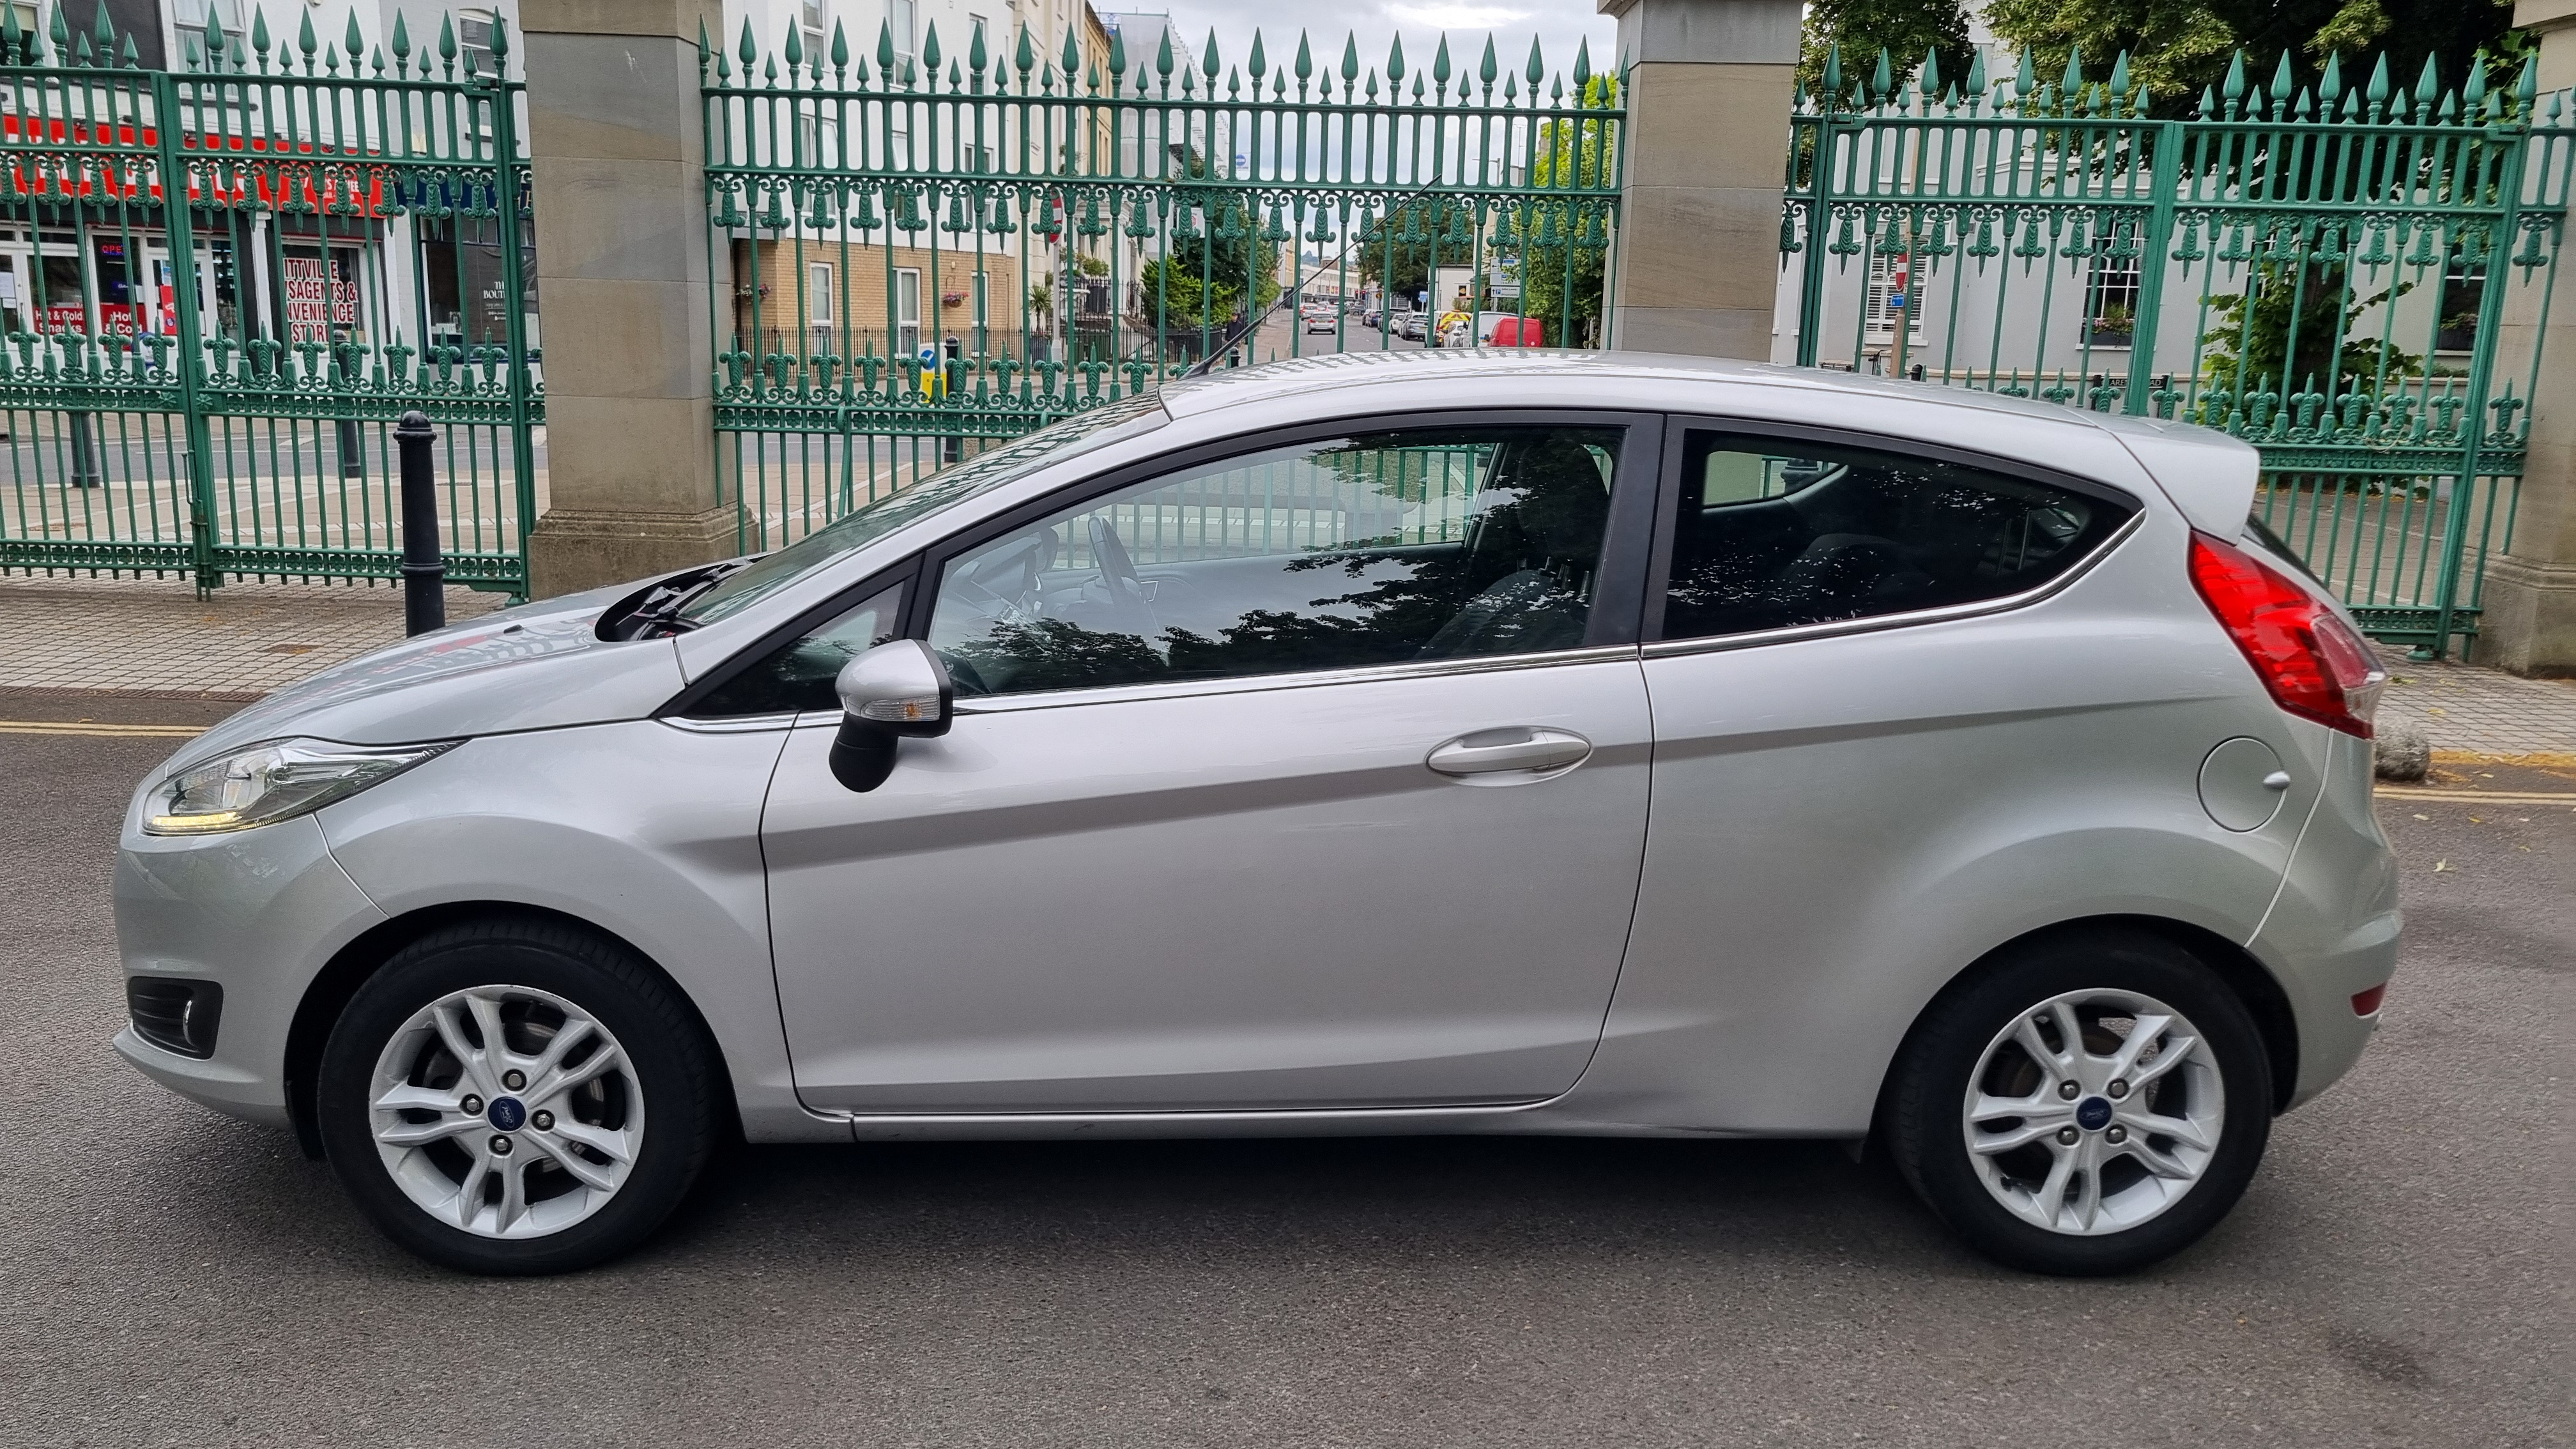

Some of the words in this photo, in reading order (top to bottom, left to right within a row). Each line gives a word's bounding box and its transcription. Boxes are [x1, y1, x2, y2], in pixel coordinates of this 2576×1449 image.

[102, 245, 122, 254] OPE
[284, 259, 338, 279] ITTVILE
[285, 280, 344, 301] SAGENTS
[348, 282, 356, 302] &
[494, 281, 505, 290] TH
[484, 290, 505, 298] BOUT
[35, 310, 52, 320] Ht
[54, 310, 60, 321] &
[62, 310, 82, 321] Cold
[287, 302, 354, 321] NVENIENCE
[39, 323, 82, 332] Snas
[116, 323, 142, 334] Cod
